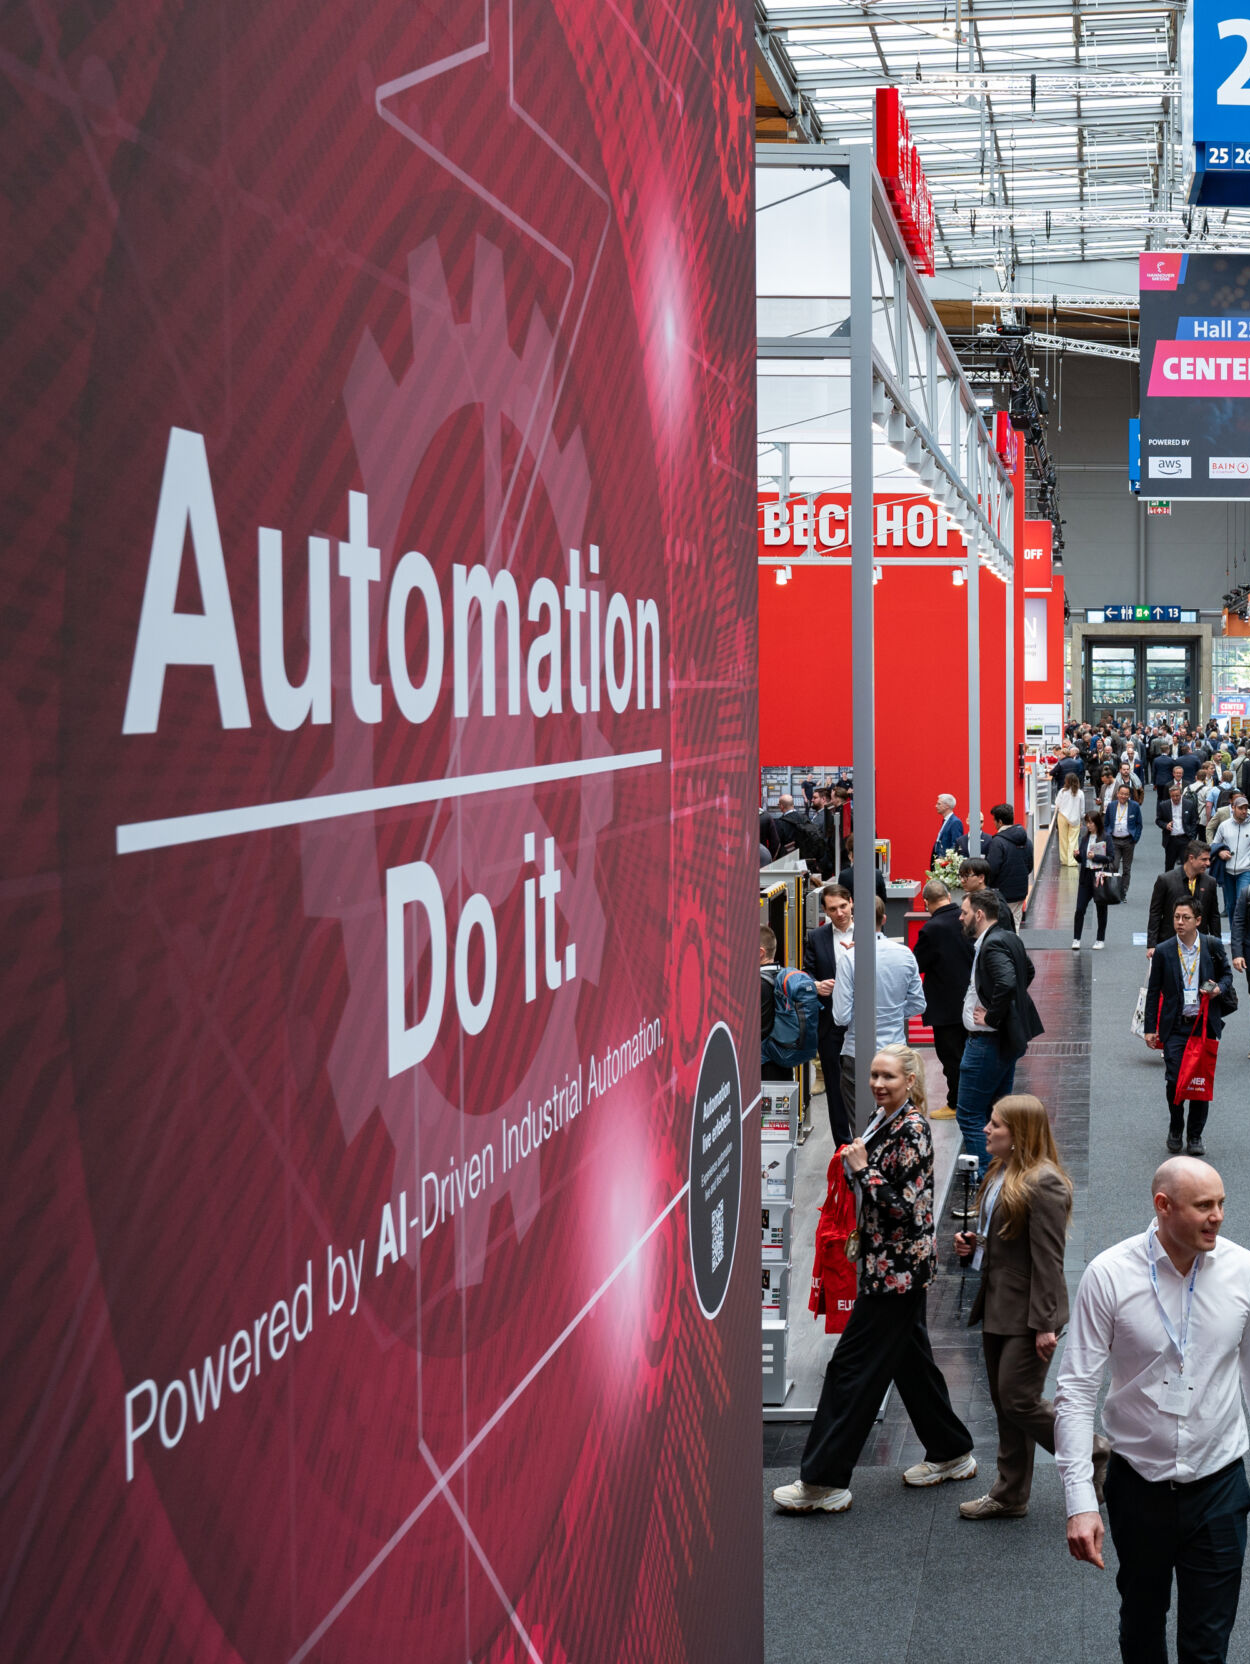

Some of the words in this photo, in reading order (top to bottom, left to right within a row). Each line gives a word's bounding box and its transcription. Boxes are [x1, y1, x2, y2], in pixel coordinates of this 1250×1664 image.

[1208, 147, 1229, 165] 25
[1193, 320, 1232, 338] Hall
[1158, 460, 1182, 468] aws
[764, 504, 968, 547] BECHOF
[121, 426, 661, 736] Automation
[1168, 608, 1179, 617] 13
[386, 860, 498, 1079] Do
[524, 832, 577, 1004] it.
[703, 1081, 731, 1123] Automation
[376, 1143, 494, 1277] AI-Driven
[502, 1064, 582, 1174] Industrial
[587, 1016, 664, 1105] Automation.
[125, 1259, 313, 1483] Powered
[327, 1239, 365, 1316] by
